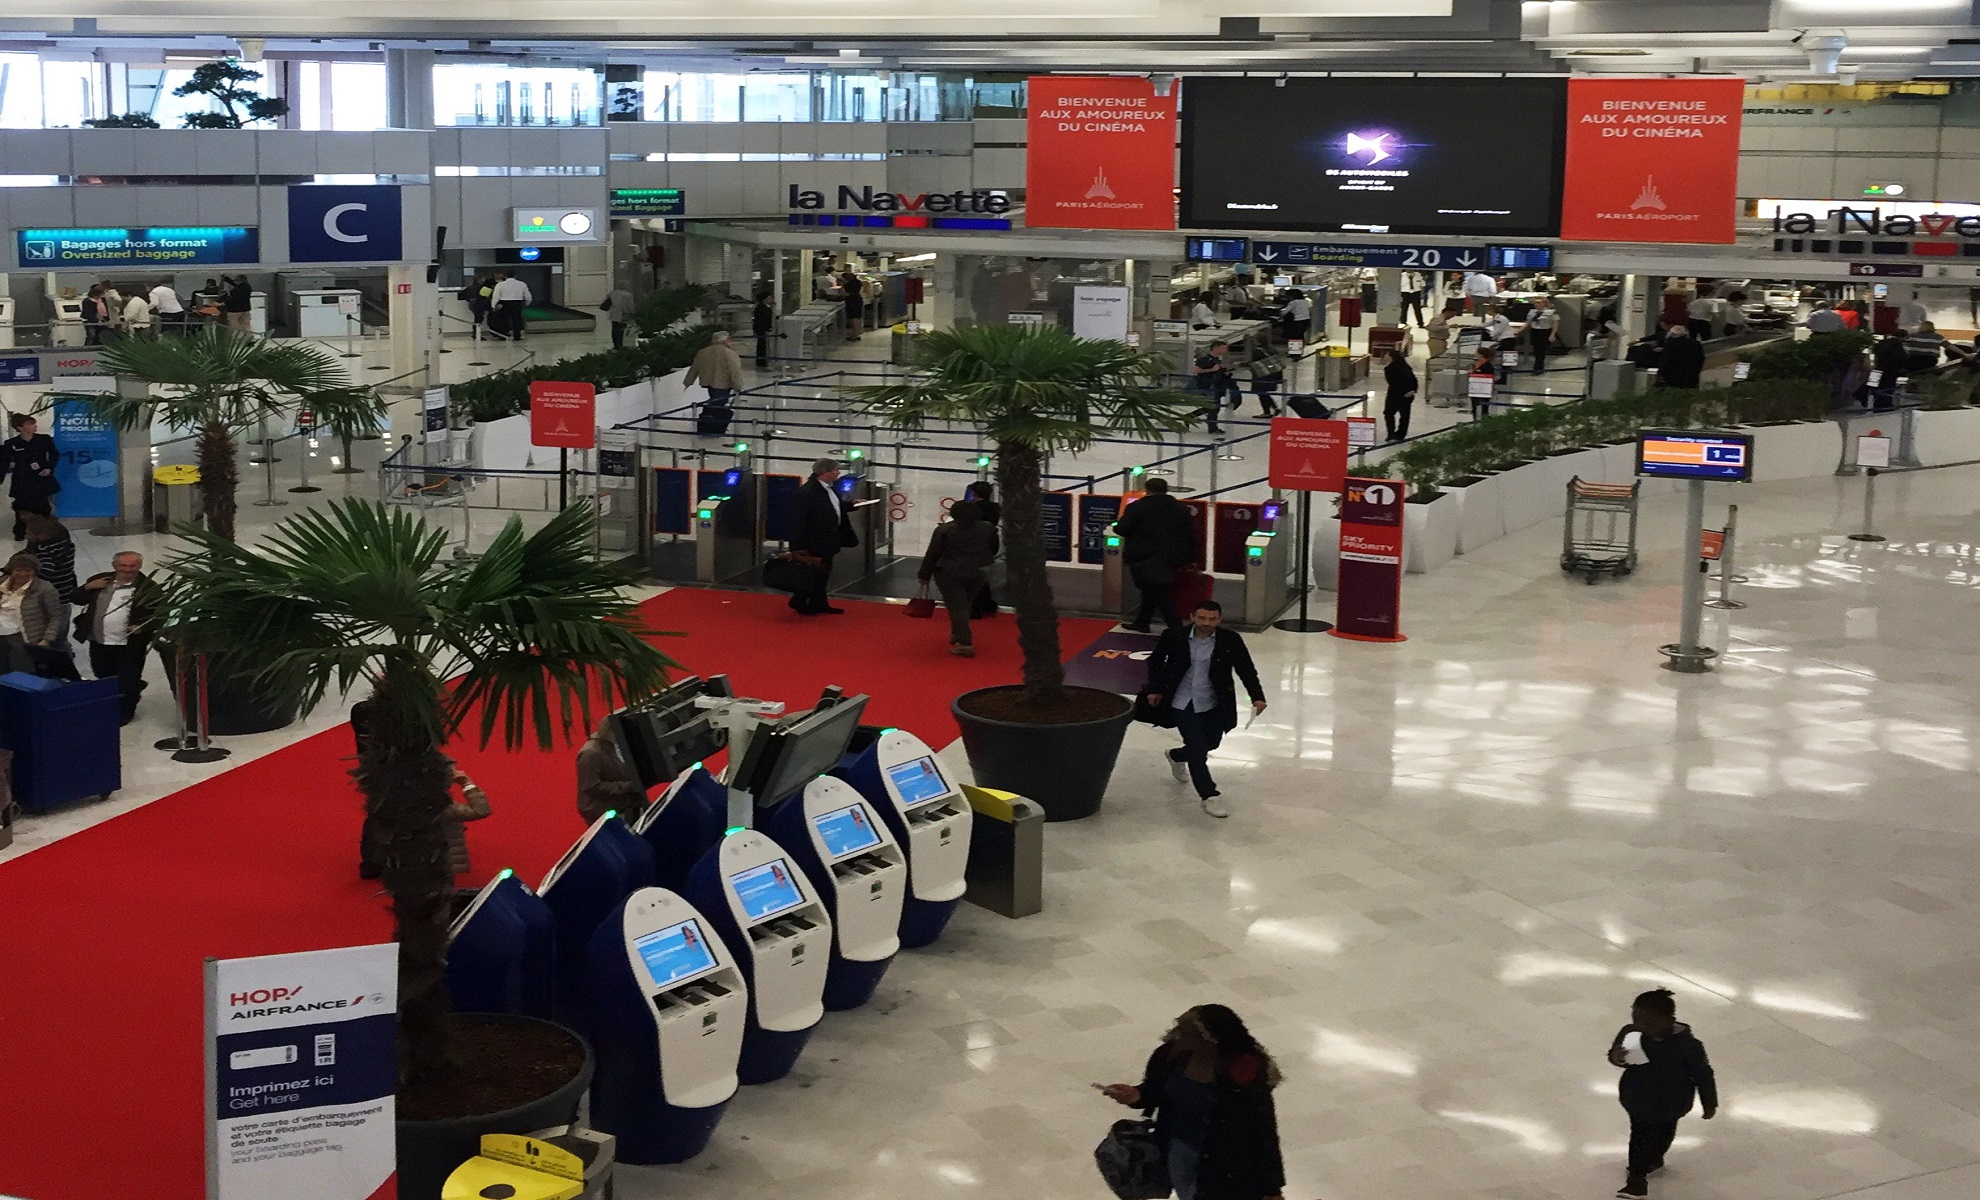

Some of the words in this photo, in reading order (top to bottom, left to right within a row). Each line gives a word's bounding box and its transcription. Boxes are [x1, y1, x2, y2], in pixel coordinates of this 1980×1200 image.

[1057, 97, 1147, 107] BIENVENUE
[1602, 101, 1707, 111] BIENVENUE
[1039, 110, 1072, 119] AUX
[1075, 110, 1166, 120] AMOUREUX
[1580, 114, 1618, 124] AUX
[1623, 114, 1727, 124] AMOUREUX
[1058, 122, 1080, 132] DU
[1084, 121, 1146, 132] CINÉMA
[1601, 127, 1628, 137] DU
[1632, 126, 1704, 138] CINÉMA
[788, 184, 826, 210] la
[838, 184, 1012, 214] Navette
[323, 202, 368, 243] C
[669, 220, 678, 231] 1
[1772, 205, 1816, 235] la
[61, 240, 122, 251] Bagages
[125, 239, 156, 248] hors
[160, 238, 208, 248] format
[61, 250, 132, 260] Oversized
[135, 249, 196, 260] baggage
[1312, 246, 1400, 256] Embarquement
[1401, 248, 1441, 267] 20
[1312, 254, 1364, 262] Boarding
[1342, 535, 1365, 543] SKY
[1342, 541, 1395, 552] PRIORITY
[230, 986, 304, 1006] HOP!
[230, 999, 348, 1021] AIRFRANCE
[229, 1078, 311, 1098] Imprimez
[314, 1074, 335, 1087] ici
[229, 1097, 260, 1110] Get
[264, 1093, 300, 1105] here
[230, 1123, 259, 1132] votre
[260, 1119, 290, 1128] carte
[230, 1132, 242, 1140] et
[244, 1128, 272, 1138] votre
[325, 1117, 367, 1128] bagage
[230, 1141, 246, 1149] de
[248, 1135, 279, 1146] soute
